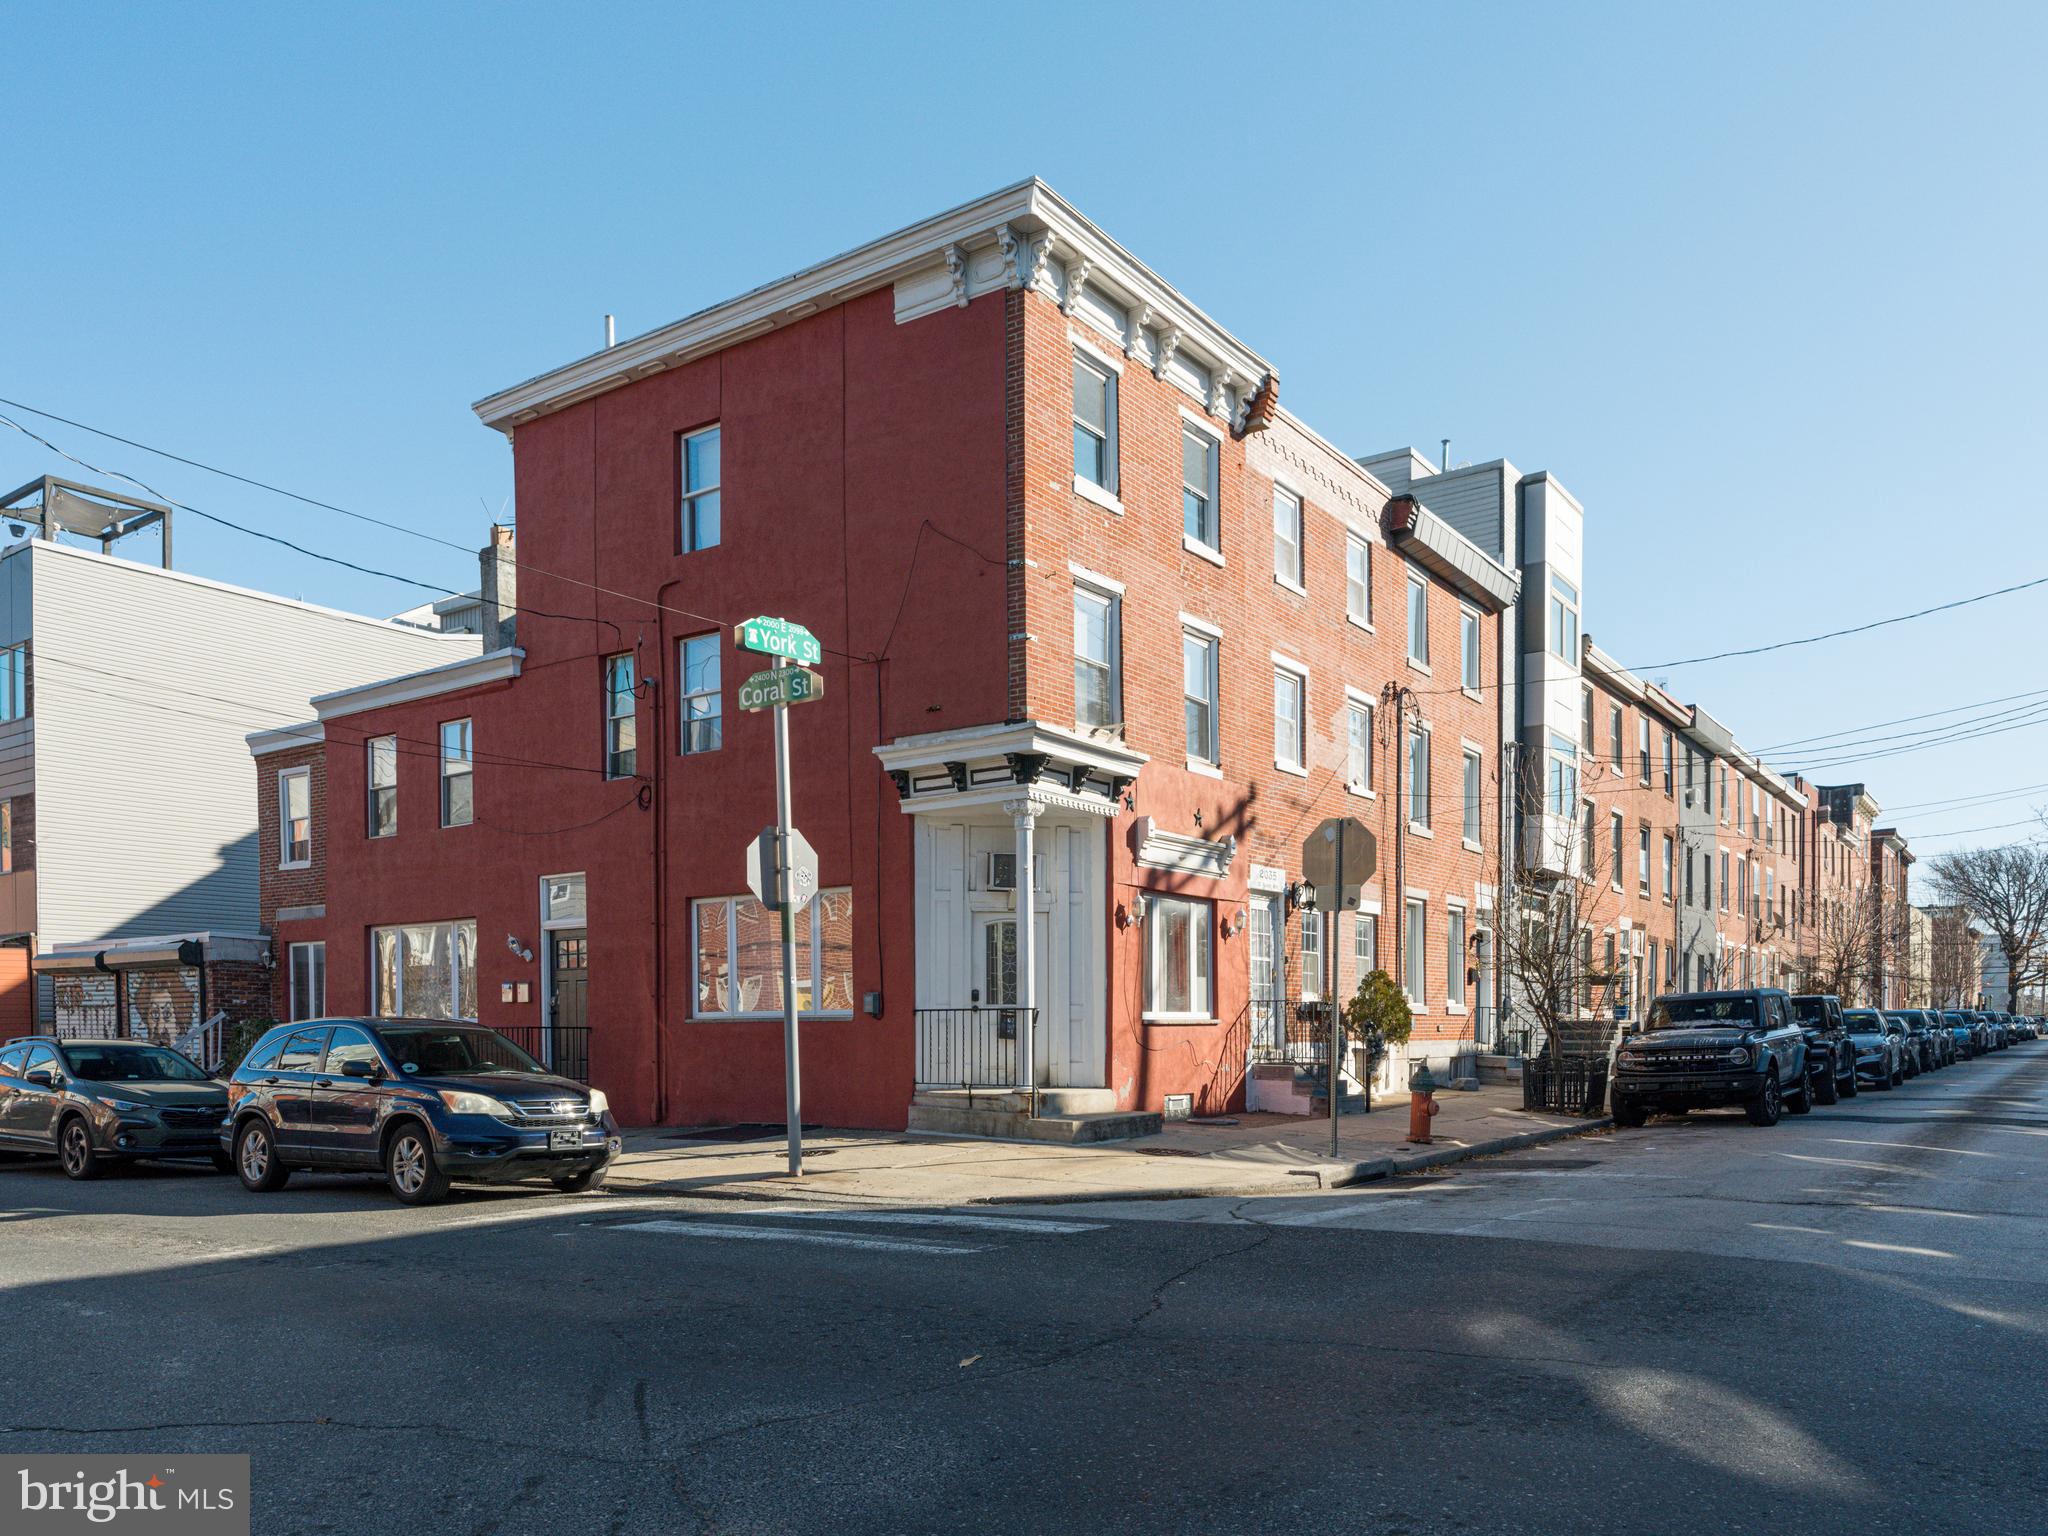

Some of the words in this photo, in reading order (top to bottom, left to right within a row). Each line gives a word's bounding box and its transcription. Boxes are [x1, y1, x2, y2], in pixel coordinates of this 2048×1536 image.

[781, 623, 786, 633] E
[760, 629, 797, 655] York
[803, 641, 819, 660] St
[771, 671, 777, 680] N
[741, 680, 785, 706] Coral
[792, 678, 808, 696] St
